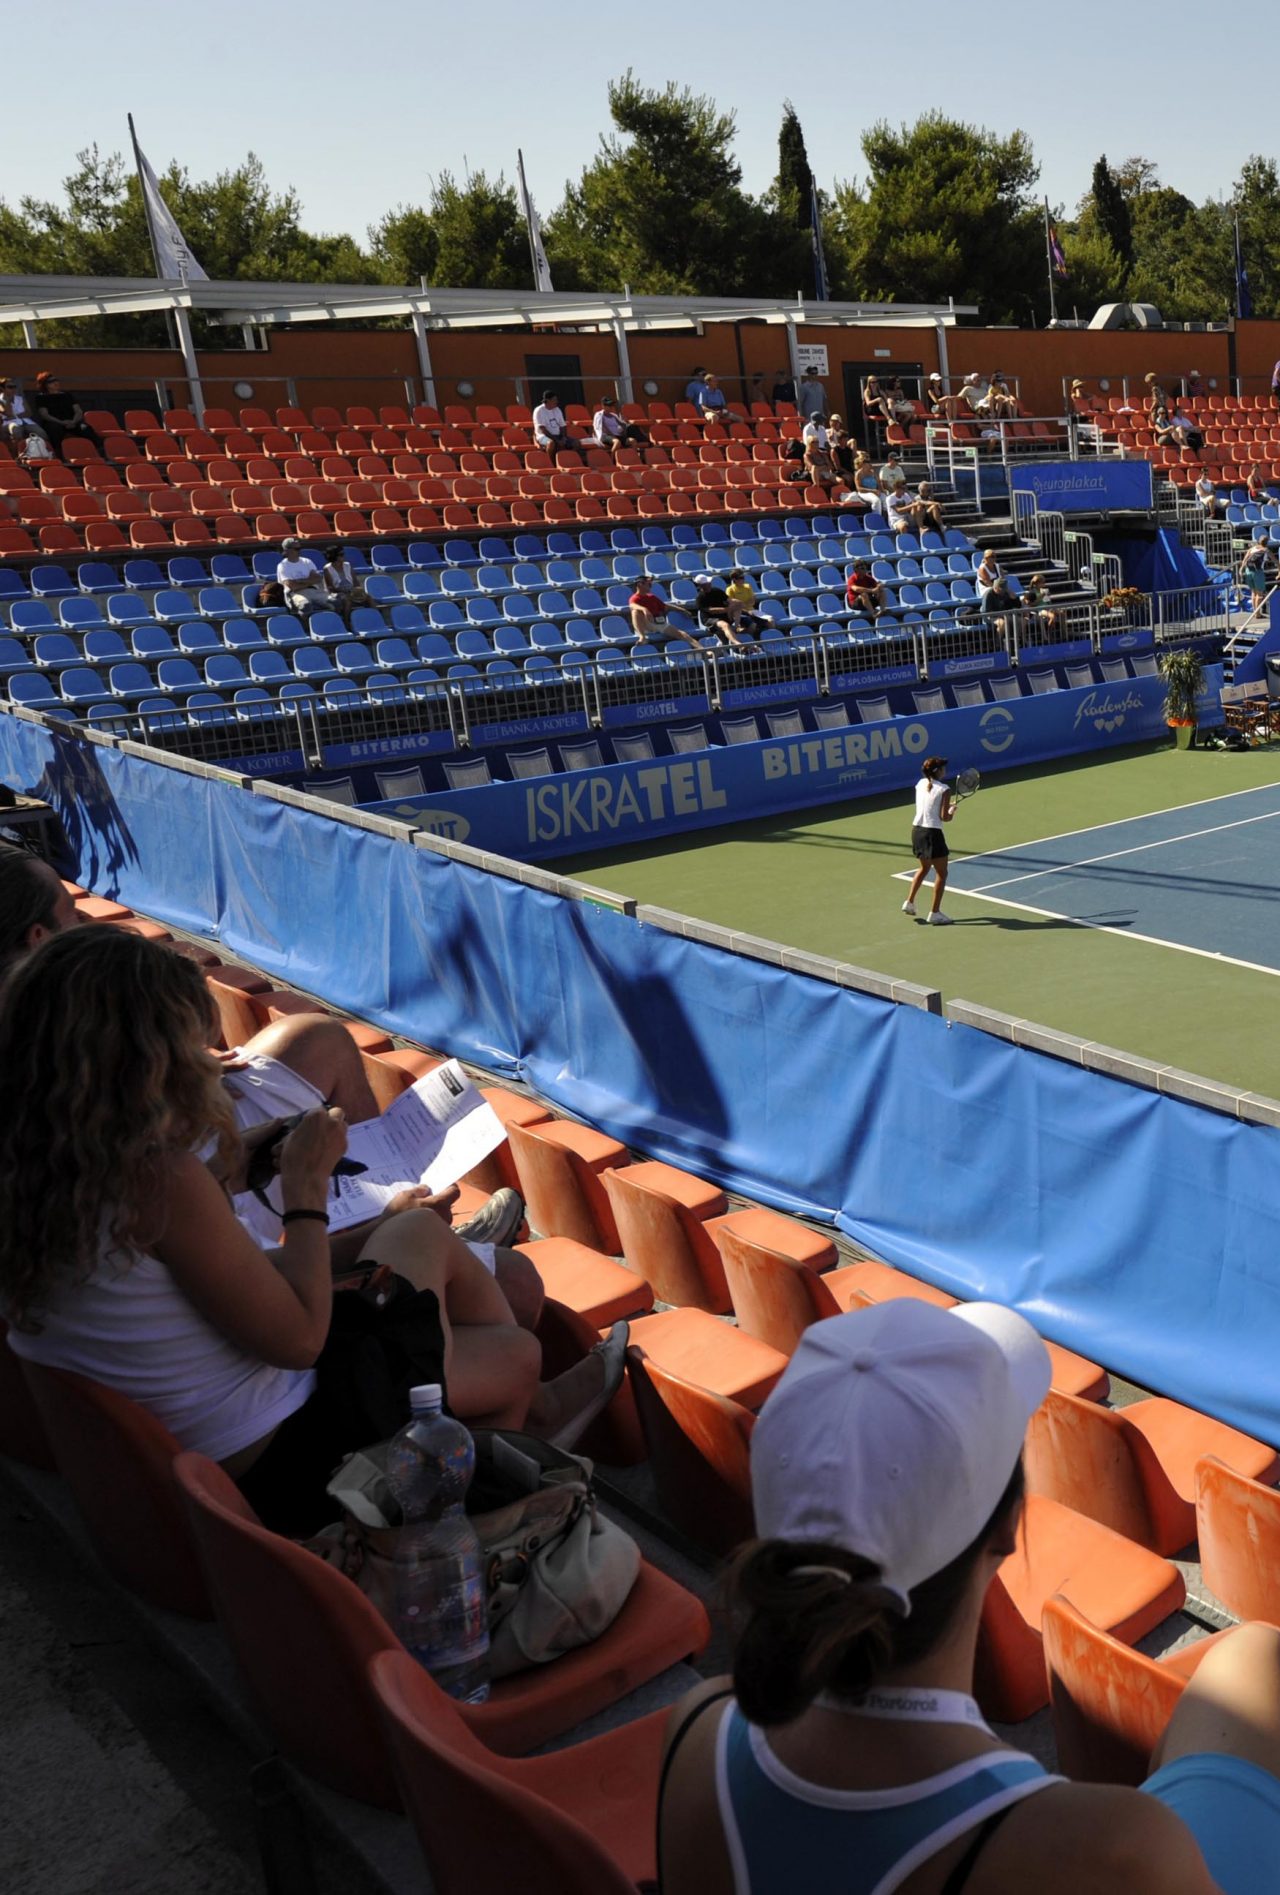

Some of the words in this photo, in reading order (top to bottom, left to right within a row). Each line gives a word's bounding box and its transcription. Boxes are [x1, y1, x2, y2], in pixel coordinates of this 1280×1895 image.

[882, 670, 913, 682] PLOVBA
[743, 688, 777, 702] BANKA
[778, 683, 808, 696] KOPER
[636, 702, 679, 719] ISKRATEL
[501, 723, 540, 737] BANKA
[543, 716, 579, 730] KOPER
[350, 735, 430, 757] BITERMO
[763, 723, 929, 781] BITERMO
[247, 755, 293, 771] KOPER
[527, 759, 727, 844] ISKRATEL
